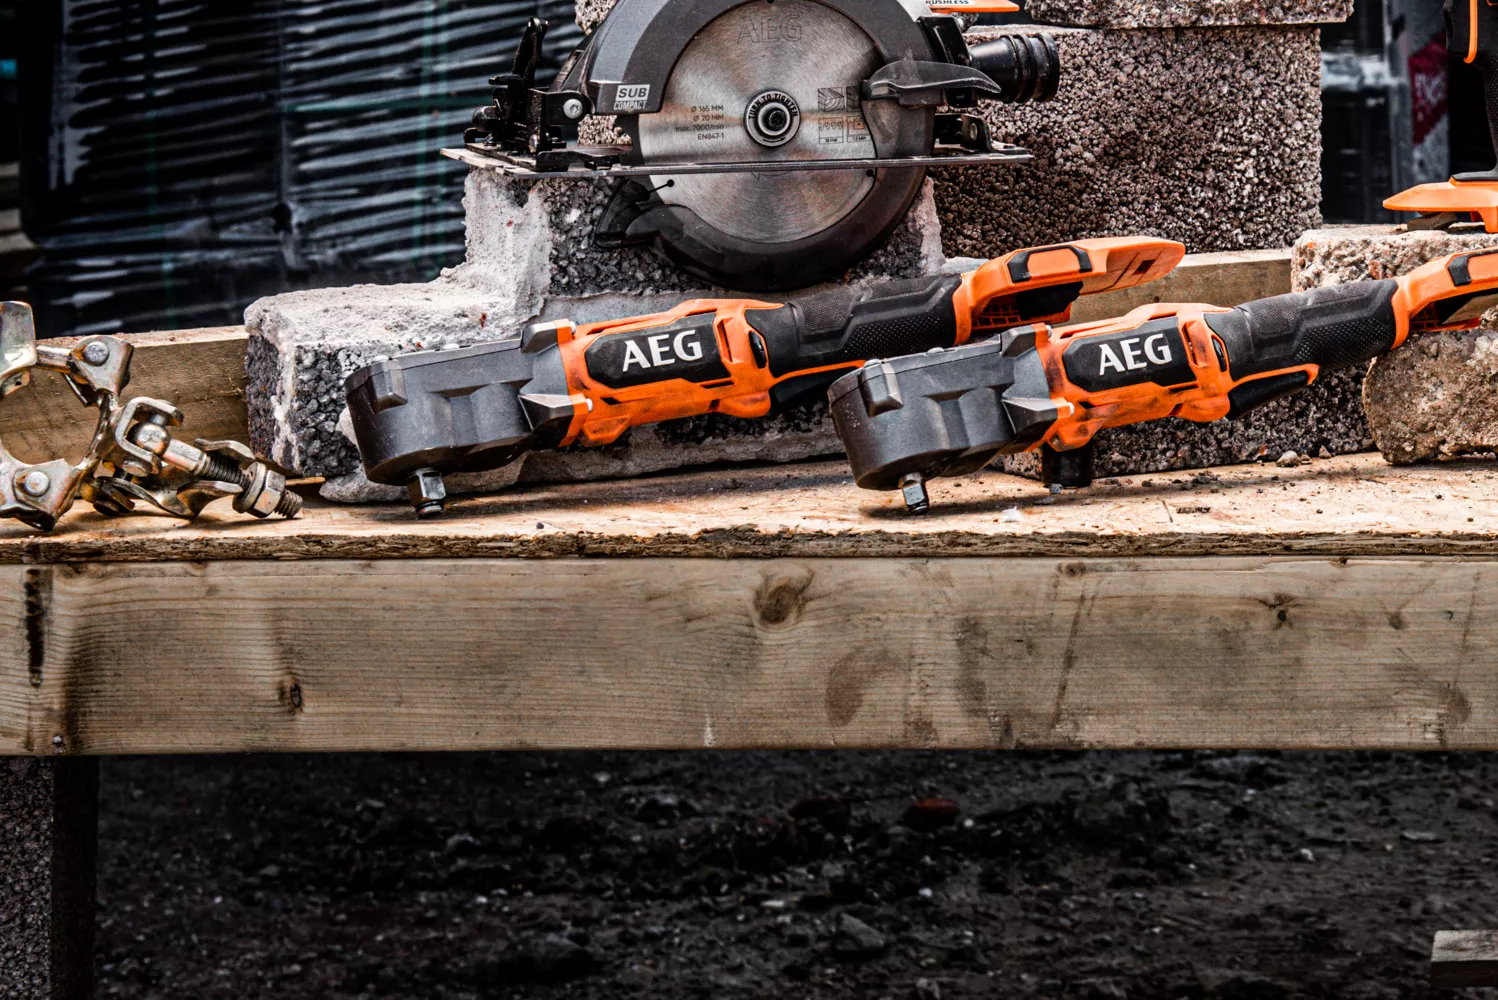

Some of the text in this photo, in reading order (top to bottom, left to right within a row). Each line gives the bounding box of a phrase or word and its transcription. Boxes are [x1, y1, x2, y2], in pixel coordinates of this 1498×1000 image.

[737, 14, 803, 44] AEG
[613, 100, 648, 110] COMPACT
[618, 87, 647, 98] SUB
[748, 93, 799, 120] TURN TO TIGHTEN
[697, 132, 725, 140] EN847-1
[622, 329, 704, 372] AEG
[1098, 332, 1173, 376] AEG
